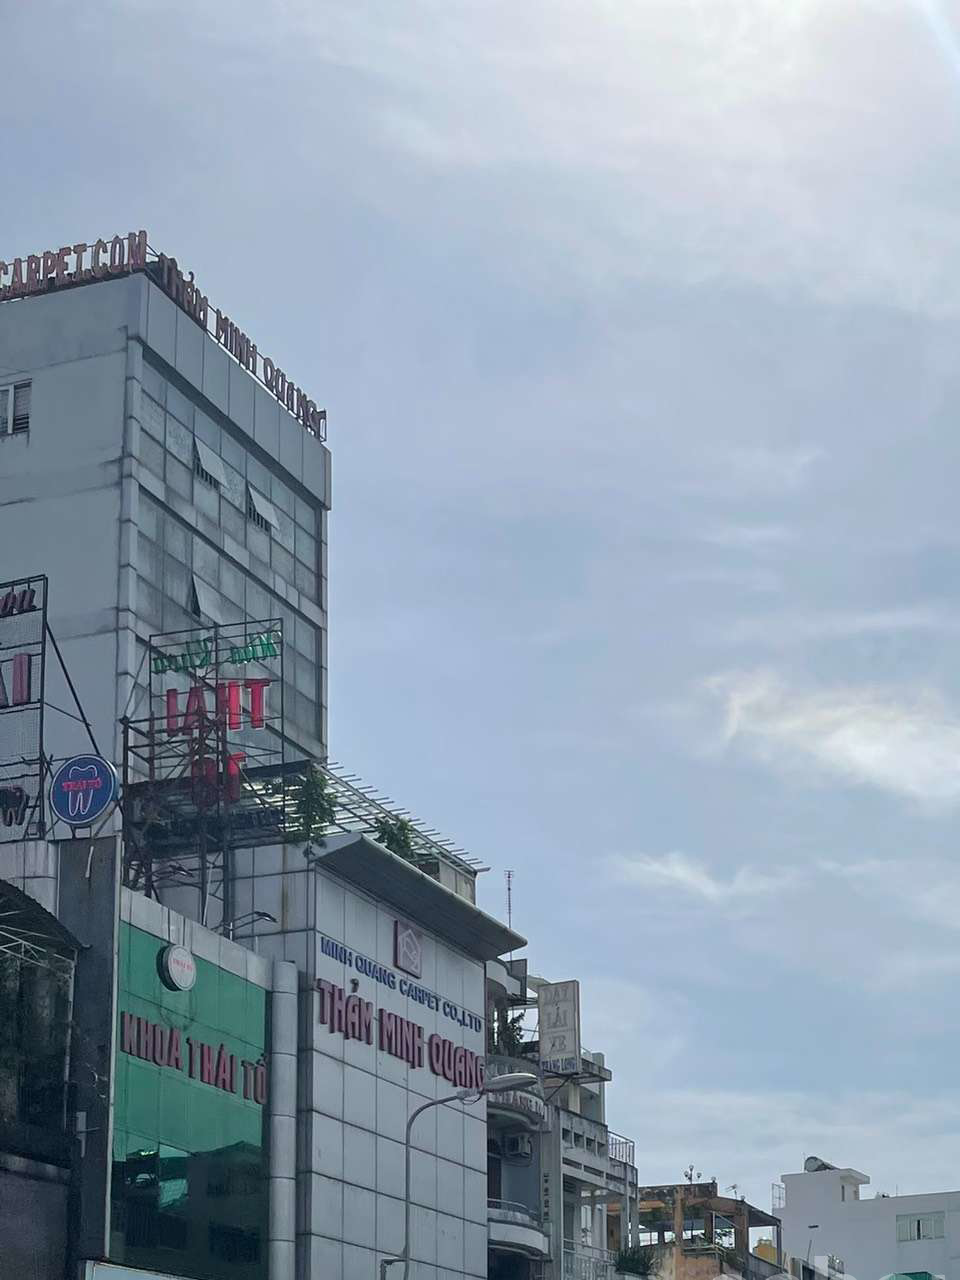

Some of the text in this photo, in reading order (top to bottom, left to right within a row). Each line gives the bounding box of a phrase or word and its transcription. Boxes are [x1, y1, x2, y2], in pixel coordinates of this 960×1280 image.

[320, 936, 353, 967] MINH
[355, 954, 396, 989] QUANG
[399, 978, 441, 1012] CARPET
[120, 1010, 184, 1072] KHOA
[317, 978, 487, 1090] THẢM MINH QUANG
